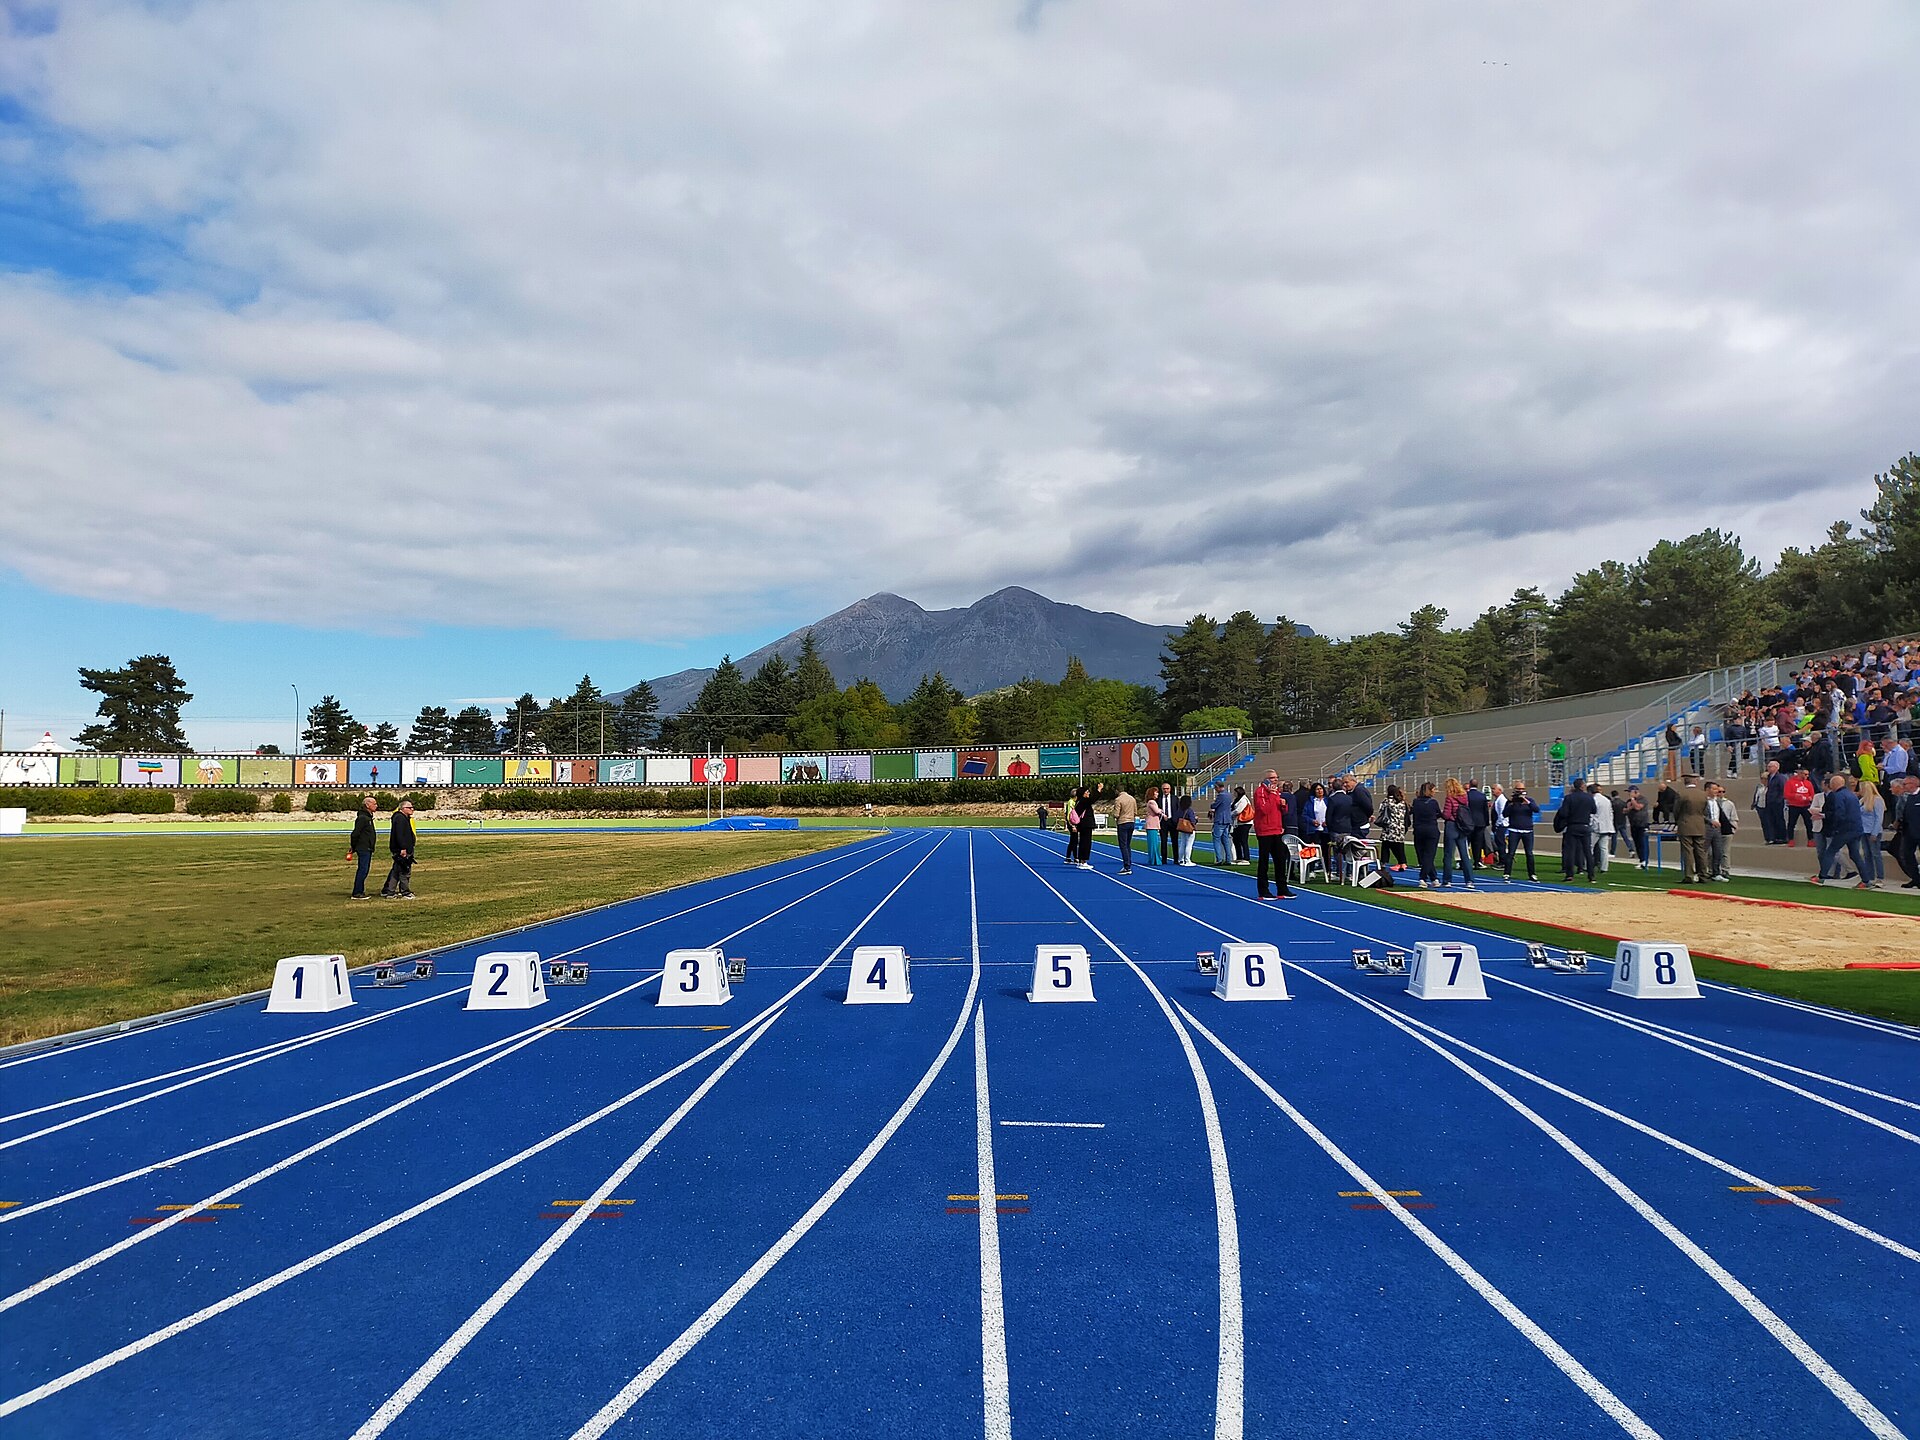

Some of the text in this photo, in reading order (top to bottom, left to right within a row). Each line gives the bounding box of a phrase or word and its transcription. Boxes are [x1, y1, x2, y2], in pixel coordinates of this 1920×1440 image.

[333, 963, 341, 995] 1
[487, 963, 509, 996] 2
[529, 960, 540, 993] 2
[679, 959, 700, 992] 3
[717, 956, 726, 988] 3
[866, 957, 887, 990] 4
[1052, 956, 1071, 988] 5
[1219, 951, 1227, 982] 6
[1244, 954, 1266, 987] 6
[1413, 949, 1423, 982] 7
[1442, 952, 1463, 985] 7
[1620, 949, 1632, 981] 8
[1654, 951, 1676, 985] 8
[292, 966, 304, 999] 1
